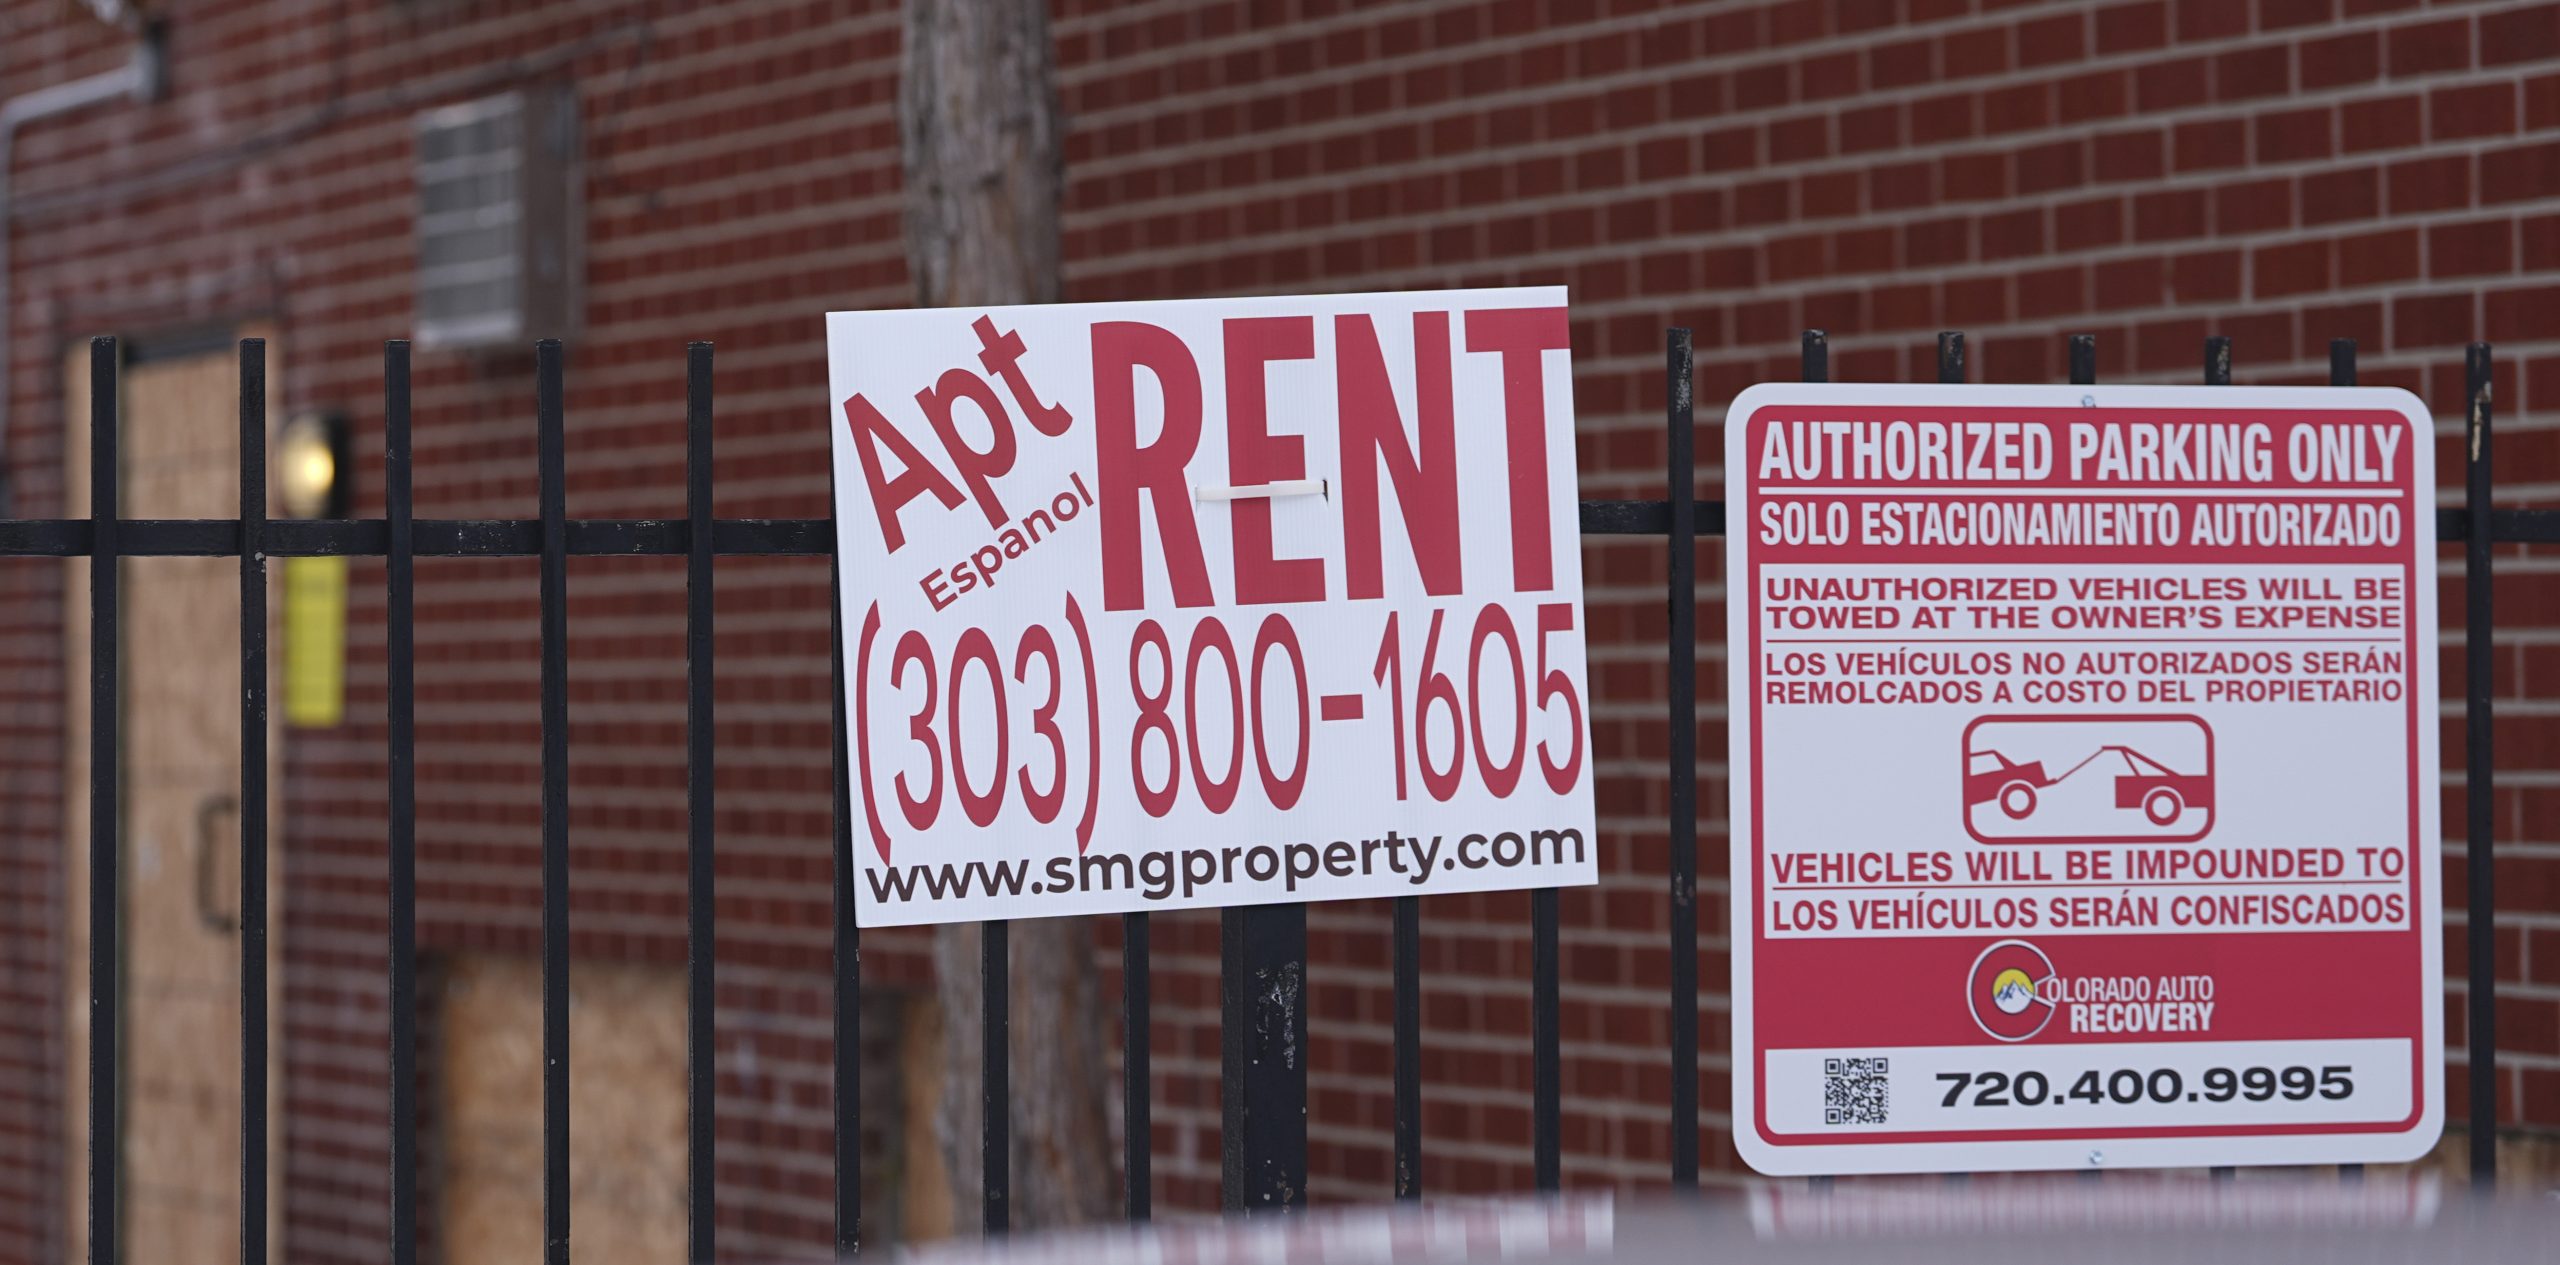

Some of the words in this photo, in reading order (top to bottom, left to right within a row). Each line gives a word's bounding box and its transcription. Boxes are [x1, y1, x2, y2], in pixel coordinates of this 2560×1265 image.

[843, 314, 1073, 555] Apt
[1759, 420, 2052, 480] AUTHORIZED
[2070, 423, 2272, 481] PARKING
[2289, 424, 2402, 481] ONLY
[1090, 306, 1569, 612] RENT
[919, 473, 1094, 612] Espanol
[1760, 502, 1849, 545] SOLO
[1862, 502, 2180, 546] ESTACIONAMIENTO
[2191, 504, 2400, 546] AUTORIZADO
[1767, 578, 2057, 601] UNAUTHORIZED
[2069, 578, 2247, 600] VEHICLES
[2258, 578, 2342, 600] WILL
[2355, 578, 2400, 600] BE
[1767, 607, 1900, 629] TOWED
[1912, 607, 1954, 628] AT
[1967, 607, 2040, 628] THE
[2235, 606, 2400, 628] EXPENSE
[1767, 653, 1827, 675] LOS
[1837, 648, 2012, 675] VEHÍCULOS
[2023, 653, 2066, 675] NO
[2076, 652, 2292, 675] AUTORIZADOS
[2303, 647, 2401, 674] SERÁN
[1767, 681, 1983, 704] REMOLCADOS
[1993, 681, 2013, 703] A
[2023, 680, 2127, 703] COSTO
[2138, 680, 2195, 702] DEL
[2207, 679, 2402, 702] PROPIETARIO
[856, 590, 1100, 868] (303)
[1128, 602, 1583, 818] 800-1605
[865, 826, 1585, 904] www.smgproperty.com
[1772, 852, 1952, 883] VEHICLES
[1965, 851, 2052, 881] WILL
[2066, 851, 2112, 880] BE
[2127, 848, 2344, 880] IMPOUNDED
[2359, 847, 2404, 877] TO
[1773, 900, 1837, 930] LOS
[1849, 891, 2038, 930] VEHÍCULOS
[2049, 890, 2158, 927] SERÁN
[2171, 894, 2404, 925] CONFISCADOS
[2157, 976, 2214, 1000] AUTO
[2070, 1003, 2214, 1033] RECOVERY
[1936, 1067, 2354, 1108] 720.400.9995
